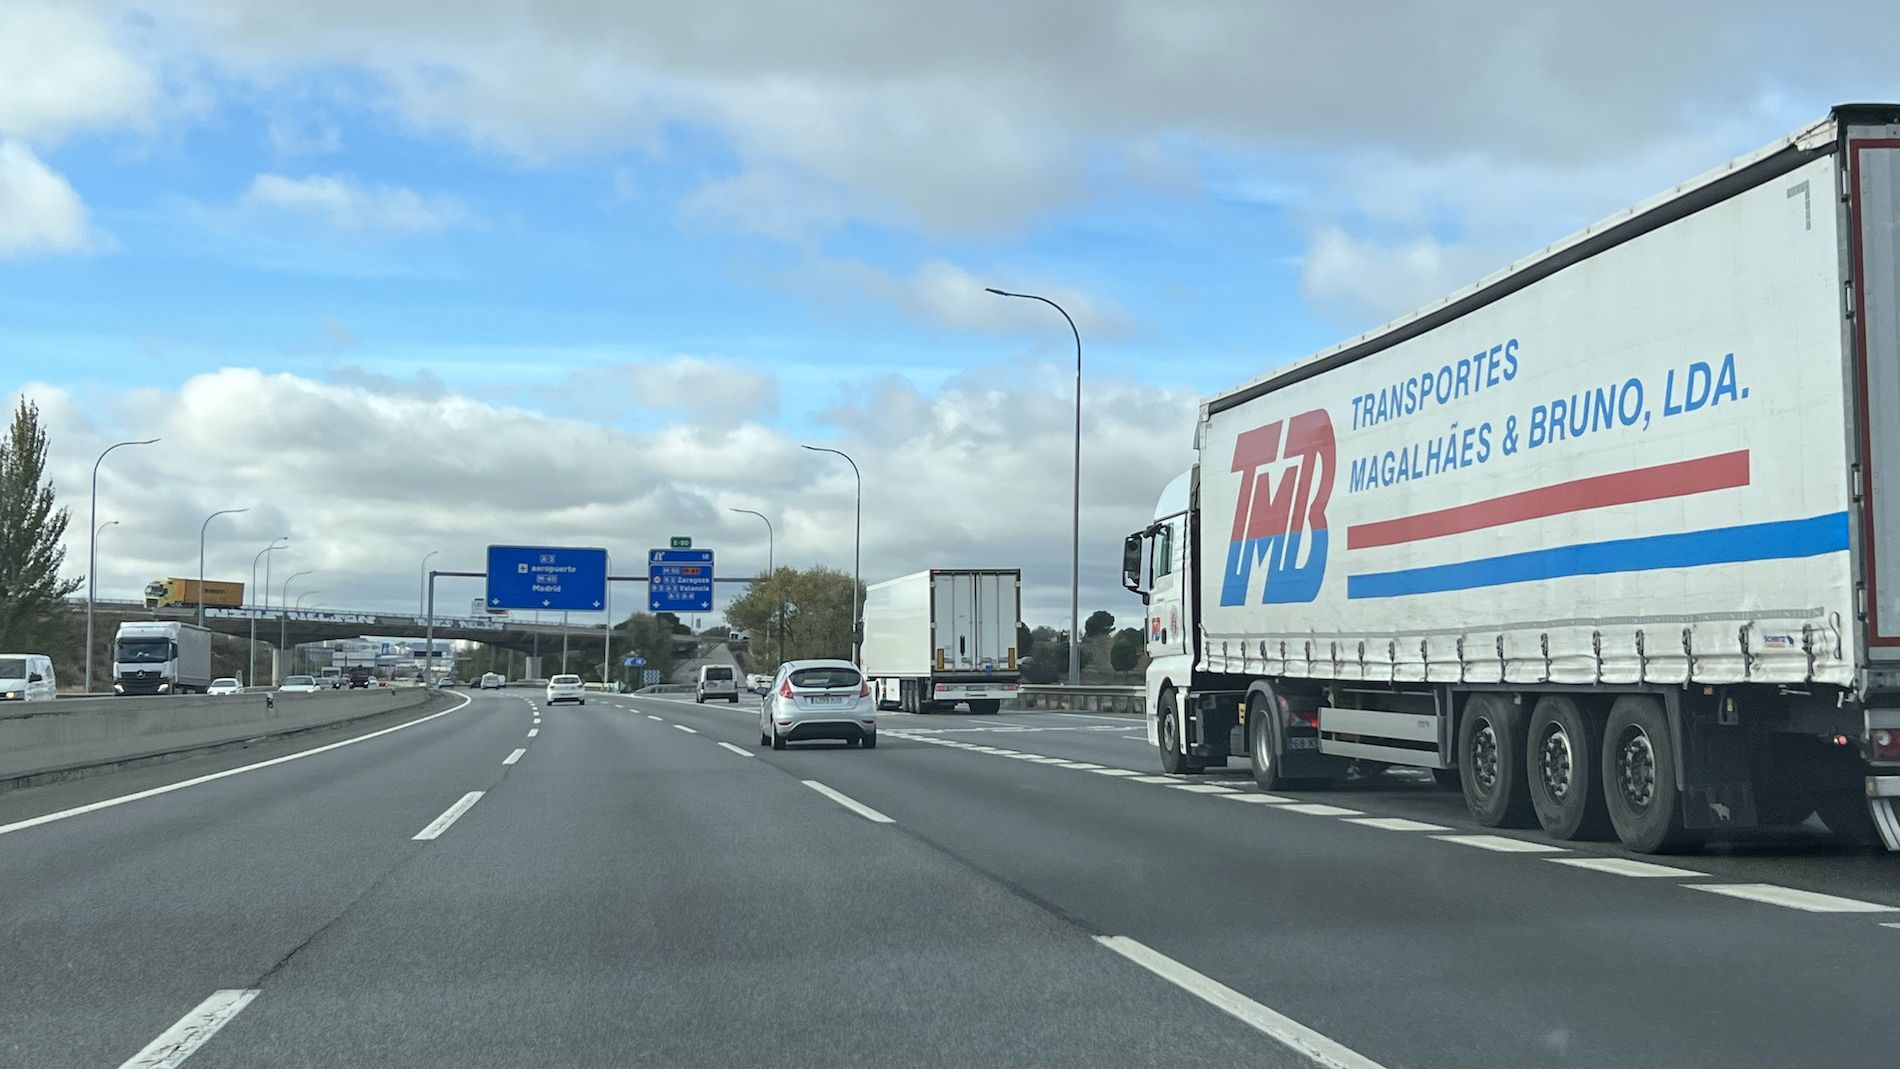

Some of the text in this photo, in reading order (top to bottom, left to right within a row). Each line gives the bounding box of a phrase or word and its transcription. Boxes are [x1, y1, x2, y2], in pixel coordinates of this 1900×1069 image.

[1349, 352, 1751, 493] MAGALHÃES & BRUNO, LDA.
[1351, 338, 1519, 432] TRANSPORTES
[1220, 408, 1336, 607] TMB
[531, 565, 577, 574] aeropuerto
[532, 584, 561, 593] Madrid
